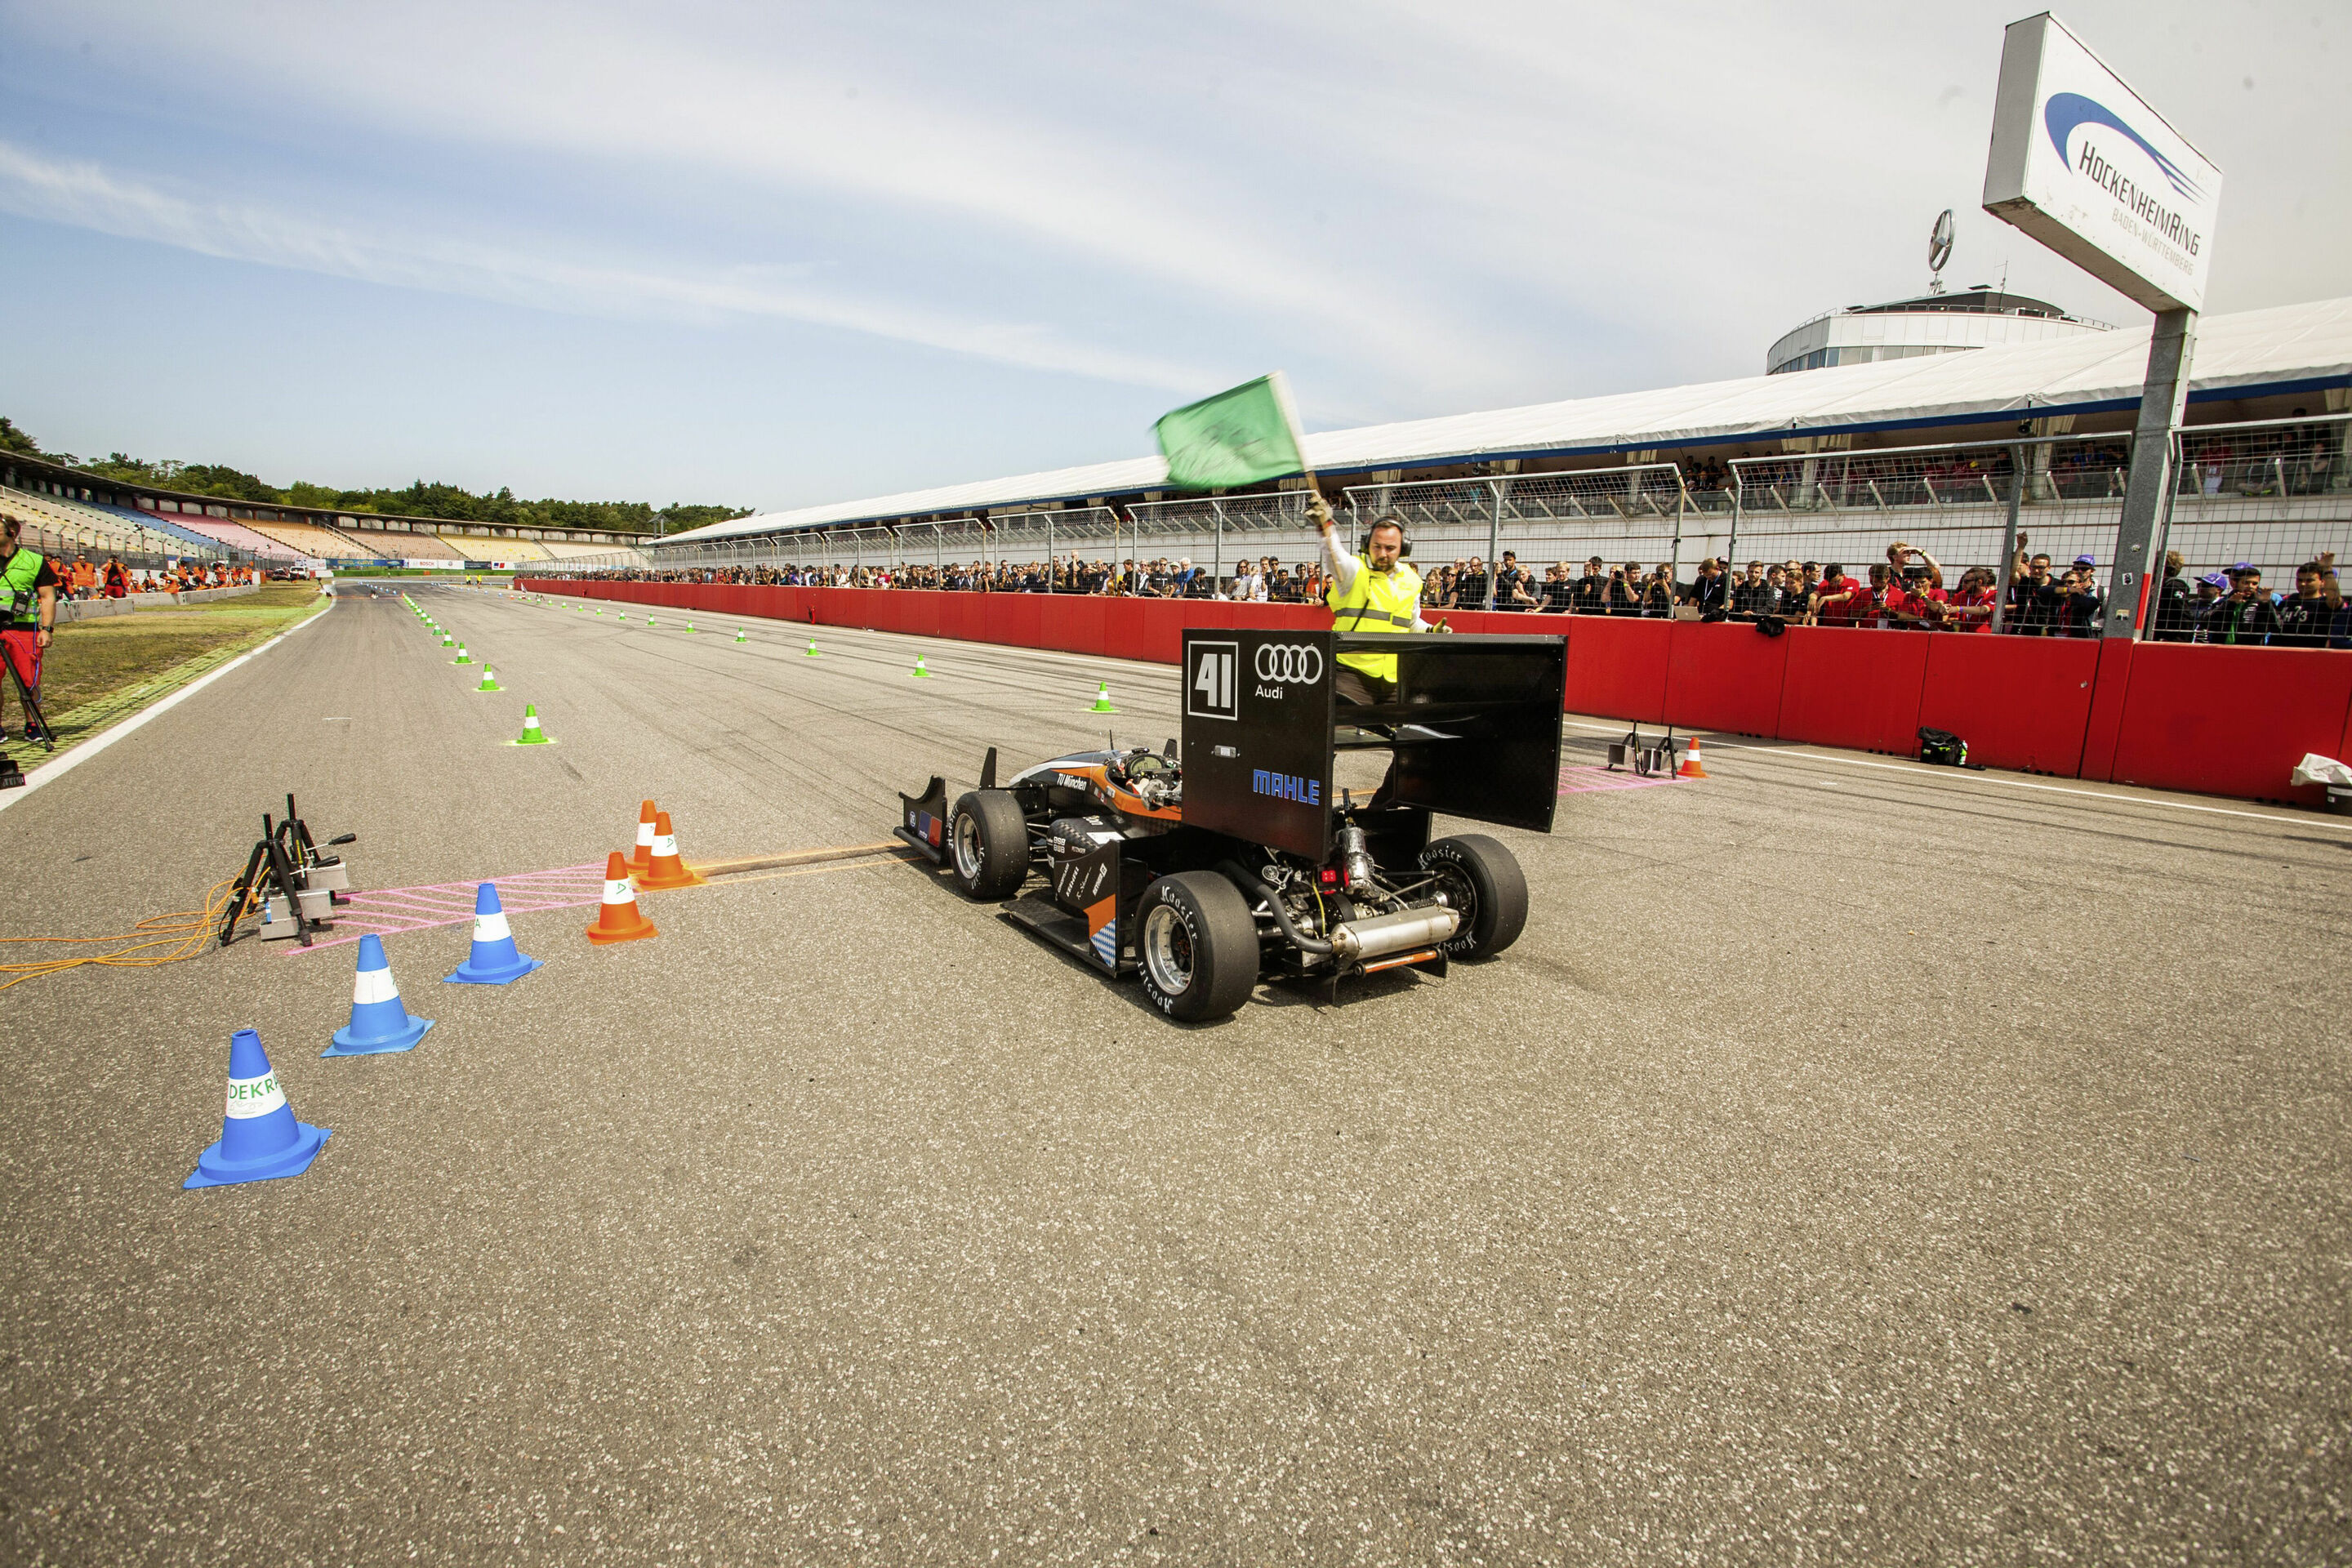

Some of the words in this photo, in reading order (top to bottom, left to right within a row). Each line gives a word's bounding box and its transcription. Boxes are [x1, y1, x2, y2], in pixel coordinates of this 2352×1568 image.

[1195, 653, 1232, 708] 41
[1255, 684, 1283, 699] Audi
[1057, 773, 1066, 786] TU
[1063, 774, 1087, 791] München
[1254, 769, 1320, 805] MAHLE
[1418, 845, 1462, 871] Hoosier
[1161, 885, 1198, 940] Hoosier
[1137, 961, 1174, 1014] Hoosier
